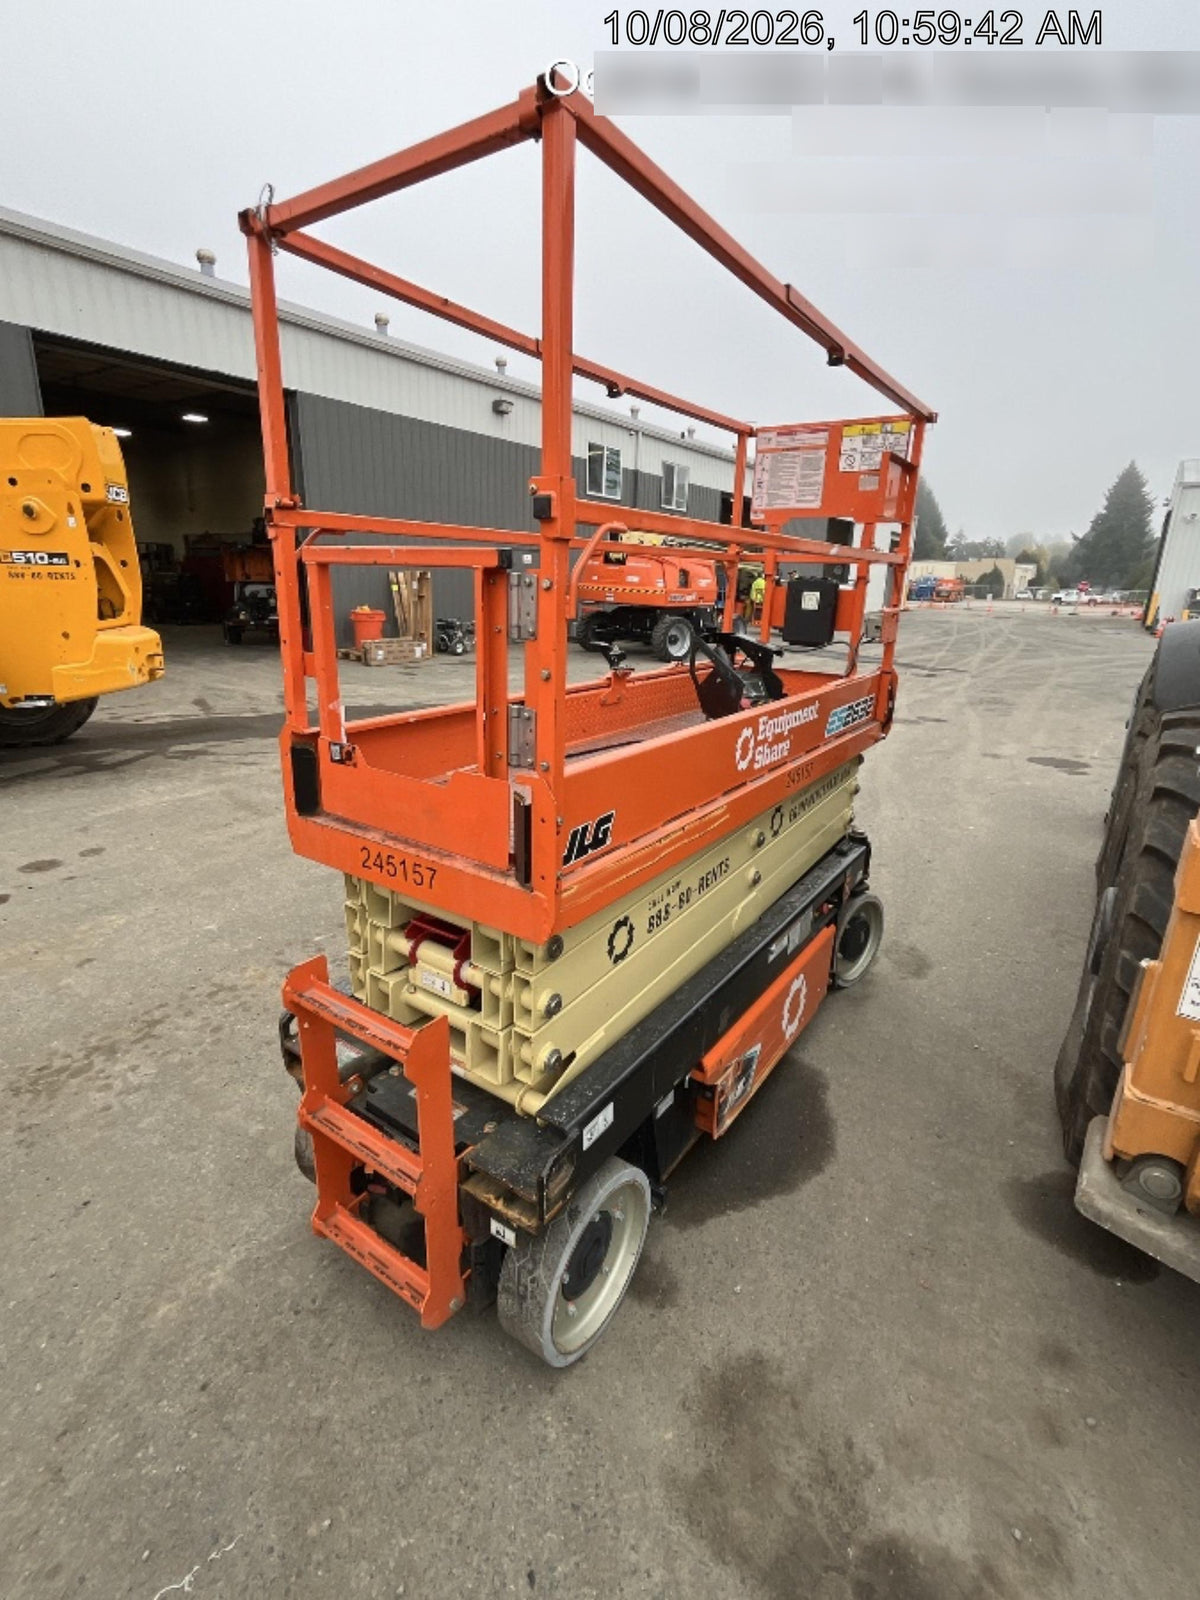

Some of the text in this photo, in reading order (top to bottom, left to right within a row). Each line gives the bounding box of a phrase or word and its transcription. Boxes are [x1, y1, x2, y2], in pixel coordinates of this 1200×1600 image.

[757, 700, 820, 742] Equipment
[753, 739, 790, 770] Share
[561, 810, 616, 869] JLG
[360, 845, 437, 890] 245157
